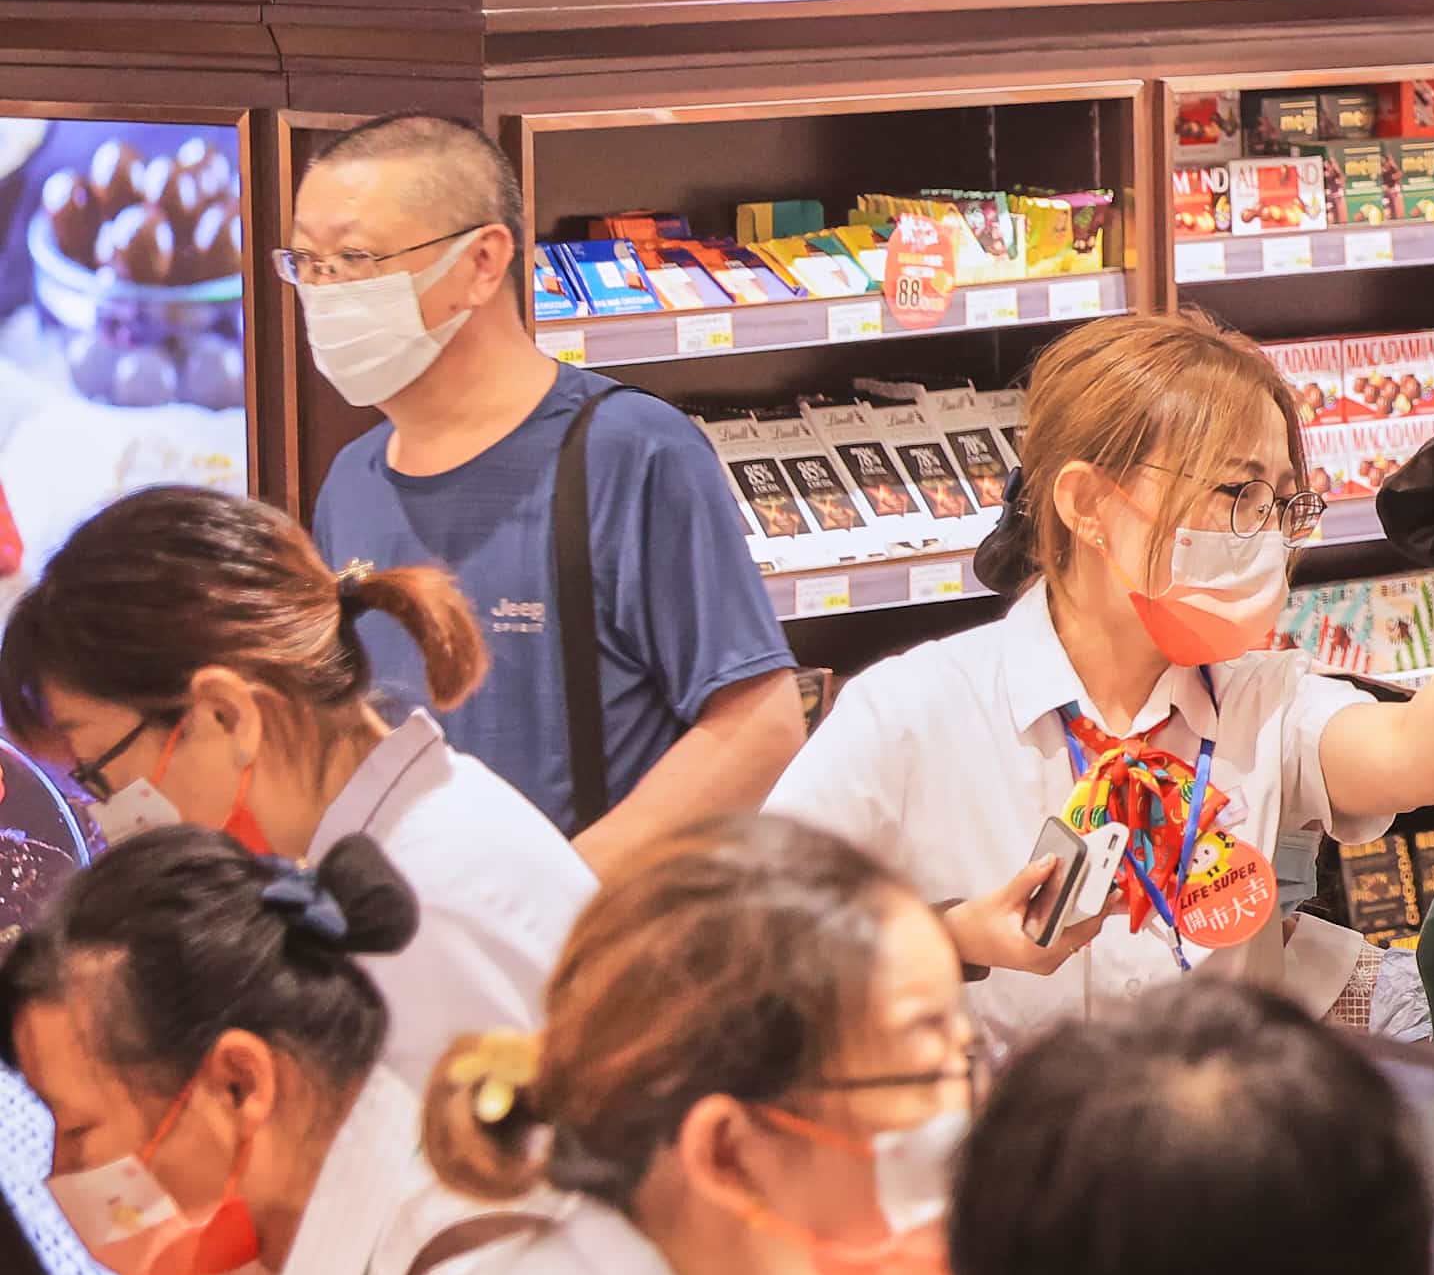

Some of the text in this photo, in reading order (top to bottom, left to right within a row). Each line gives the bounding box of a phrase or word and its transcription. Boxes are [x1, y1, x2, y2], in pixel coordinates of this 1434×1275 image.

[490, 597, 545, 623] Jeep
[1182, 875, 1270, 935] 開市大吉
